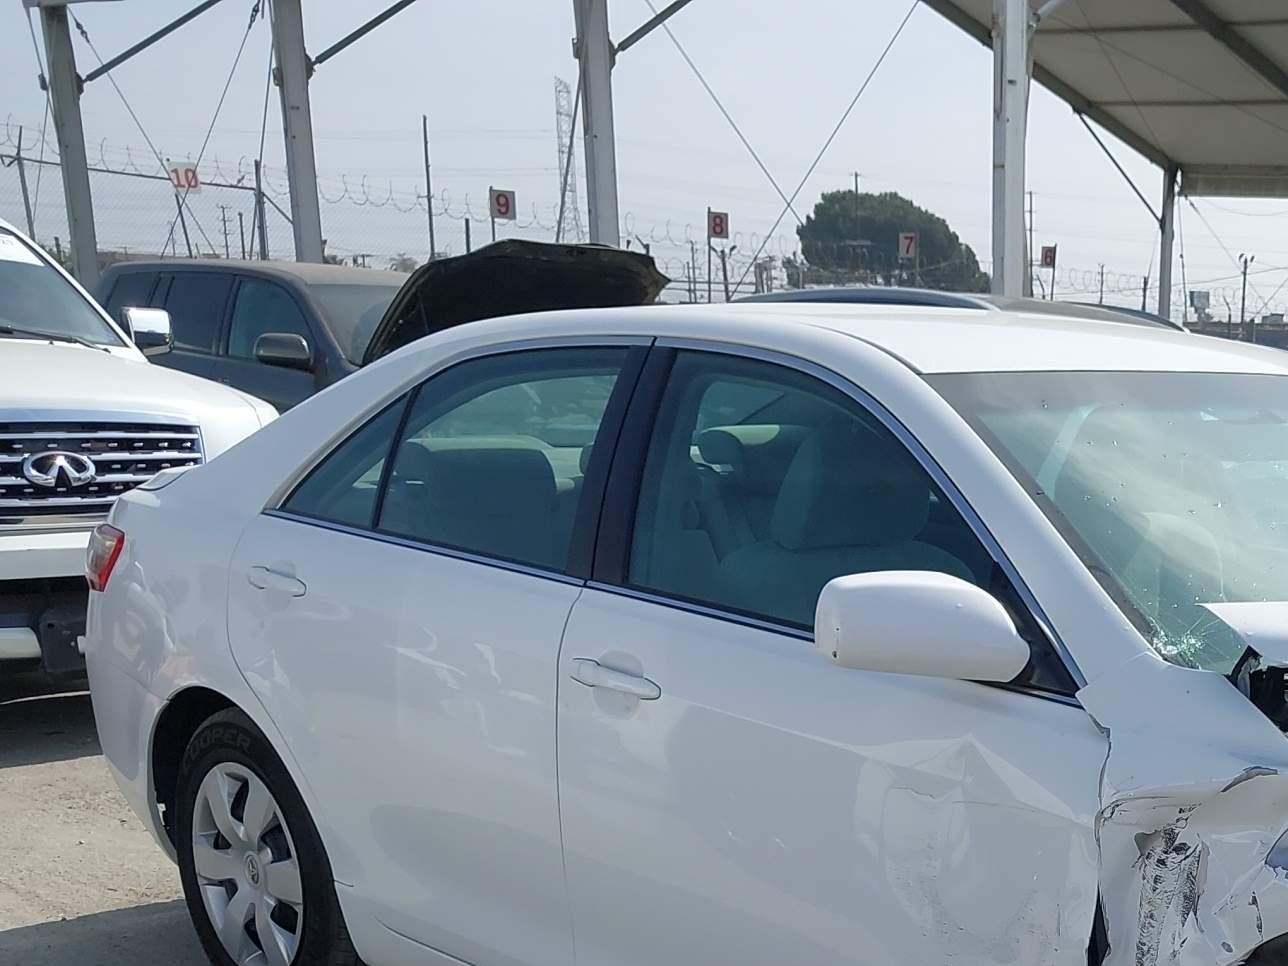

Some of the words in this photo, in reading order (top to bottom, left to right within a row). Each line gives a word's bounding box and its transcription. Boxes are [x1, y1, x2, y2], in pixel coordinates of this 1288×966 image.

[170, 167, 199, 189] 10
[495, 193, 509, 216] 9
[712, 215, 724, 235] 8
[903, 235, 914, 255] 7
[1044, 249, 1053, 266] 6
[182, 727, 251, 776] COOPER
